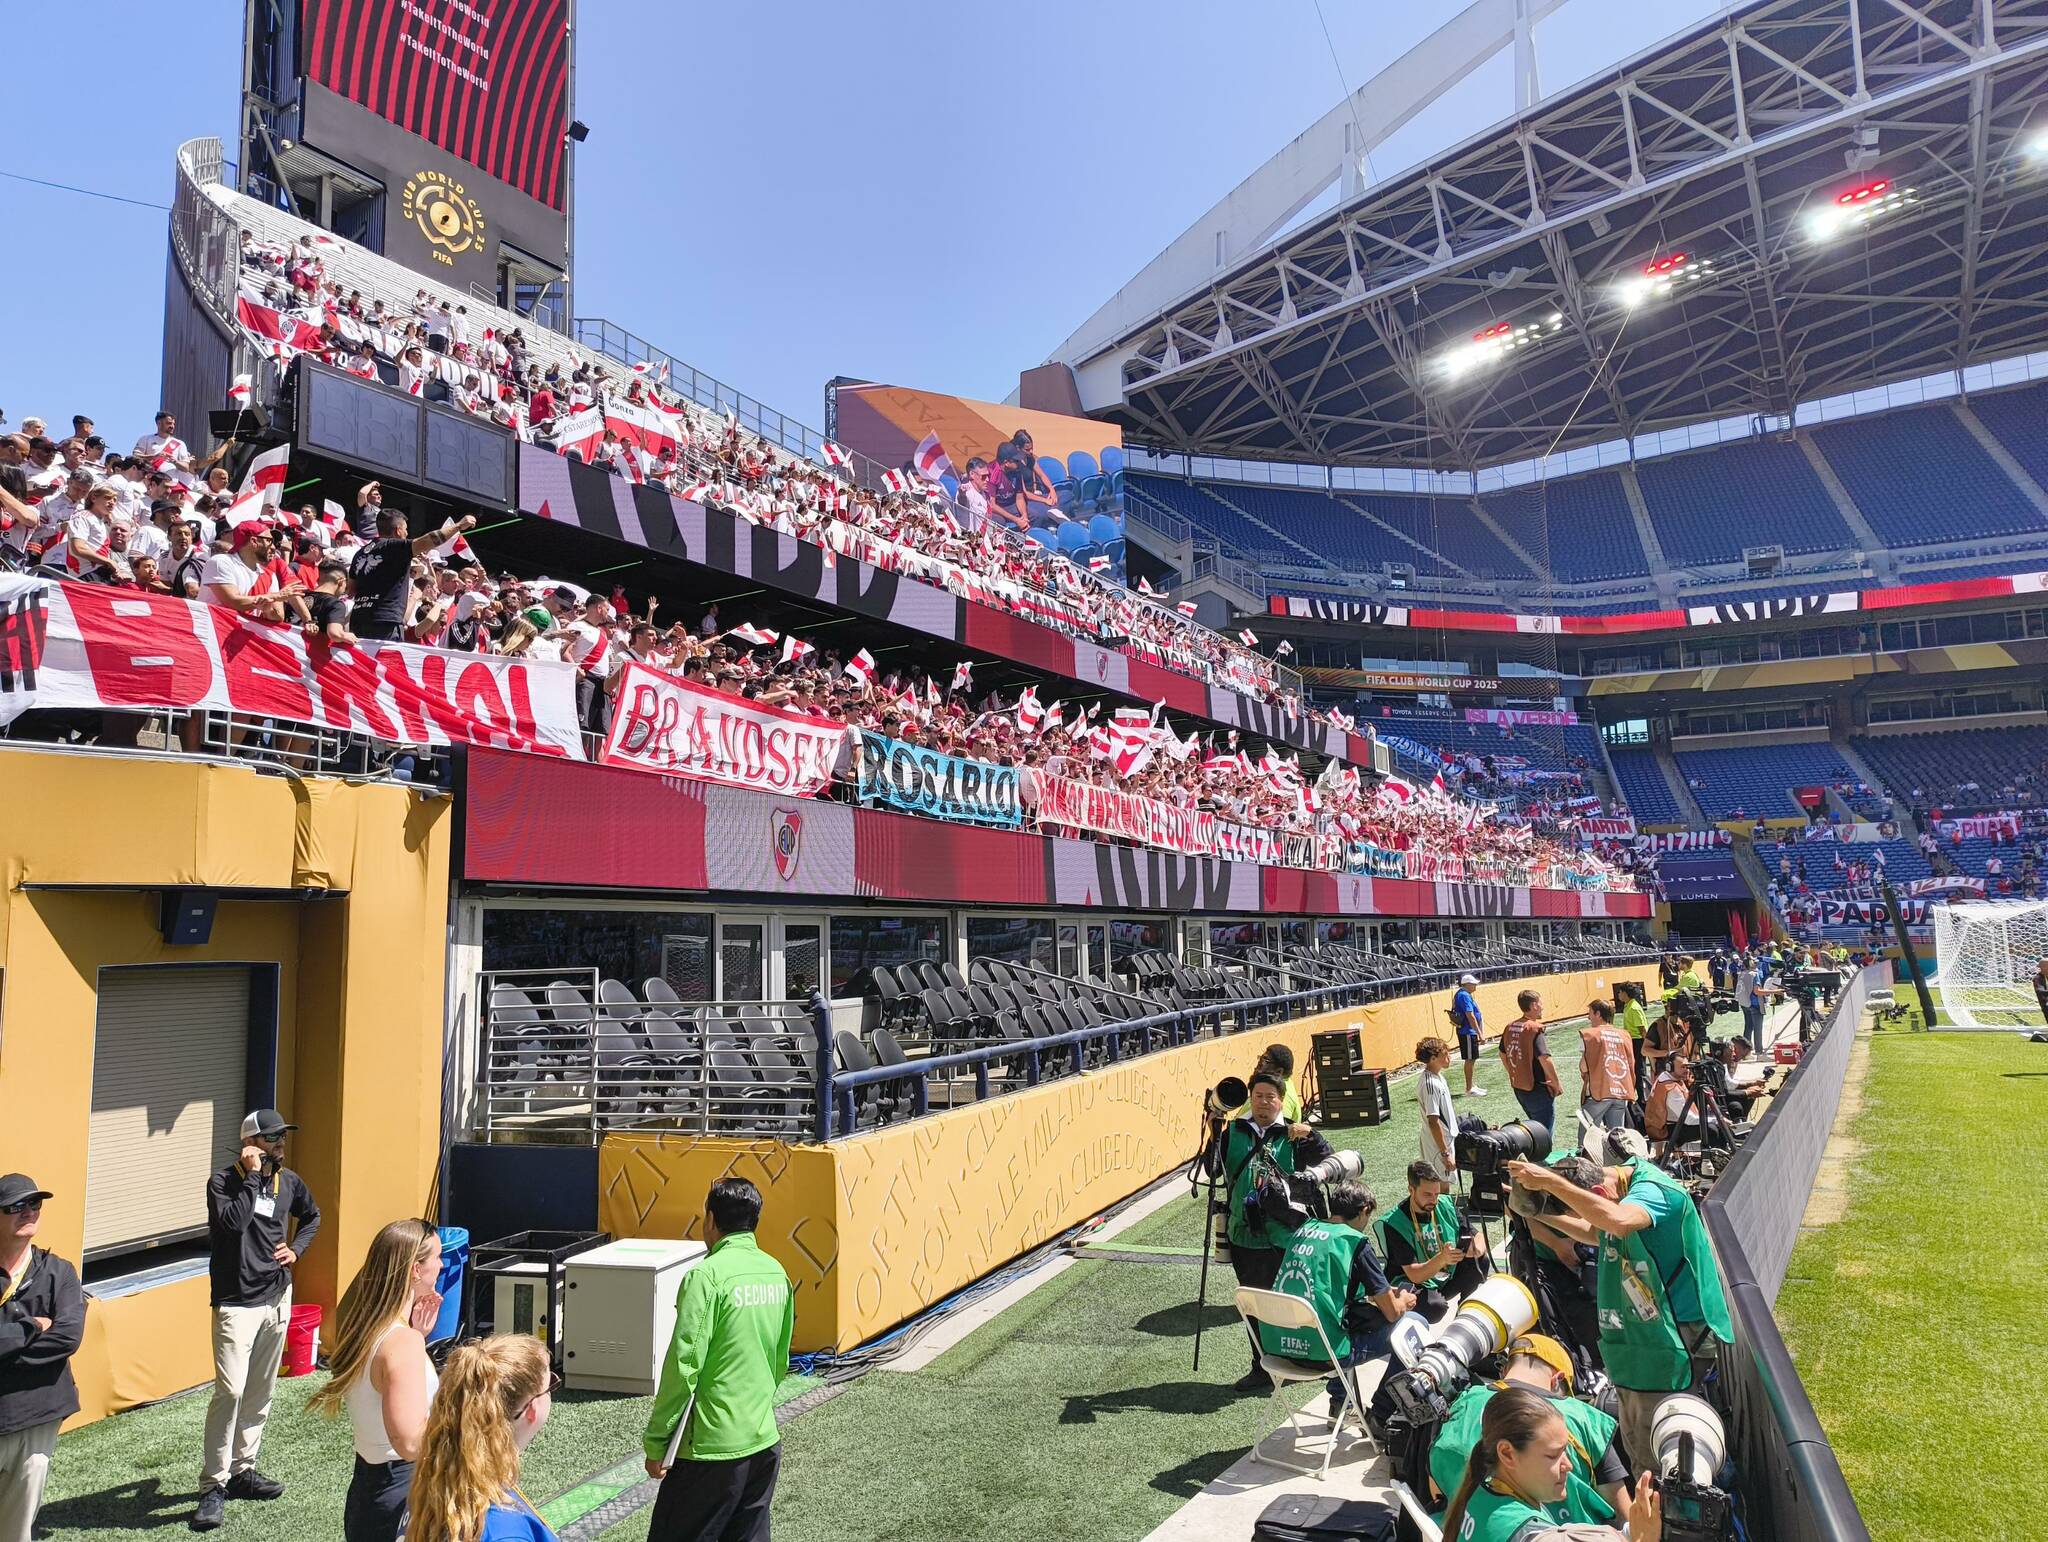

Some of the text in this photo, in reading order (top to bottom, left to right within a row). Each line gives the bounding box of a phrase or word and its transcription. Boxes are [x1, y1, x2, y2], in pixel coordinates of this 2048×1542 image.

[400, 32, 488, 92] #TakeItToTheWorld
[403, 171, 485, 253] CLUB WORLD CUP 25
[432, 250, 453, 266] FIFA
[608, 396, 634, 416] Gonza
[1748, 546, 1775, 556] 304
[59, 580, 569, 758] BERNAL
[1366, 675, 1387, 685] FIFA
[1389, 676, 1414, 686] CLUB
[1416, 677, 1451, 687] WORLD
[1453, 679, 1471, 688] CUP
[617, 684, 842, 791] BRANDSEN
[862, 734, 1017, 818] ROSARIO
[1580, 818, 1633, 834] MARTIN
[1660, 873, 1735, 884] UMEN
[1071, 1132, 1122, 1196] CLUBE
[1285, 1259, 1312, 1275] WORLD
